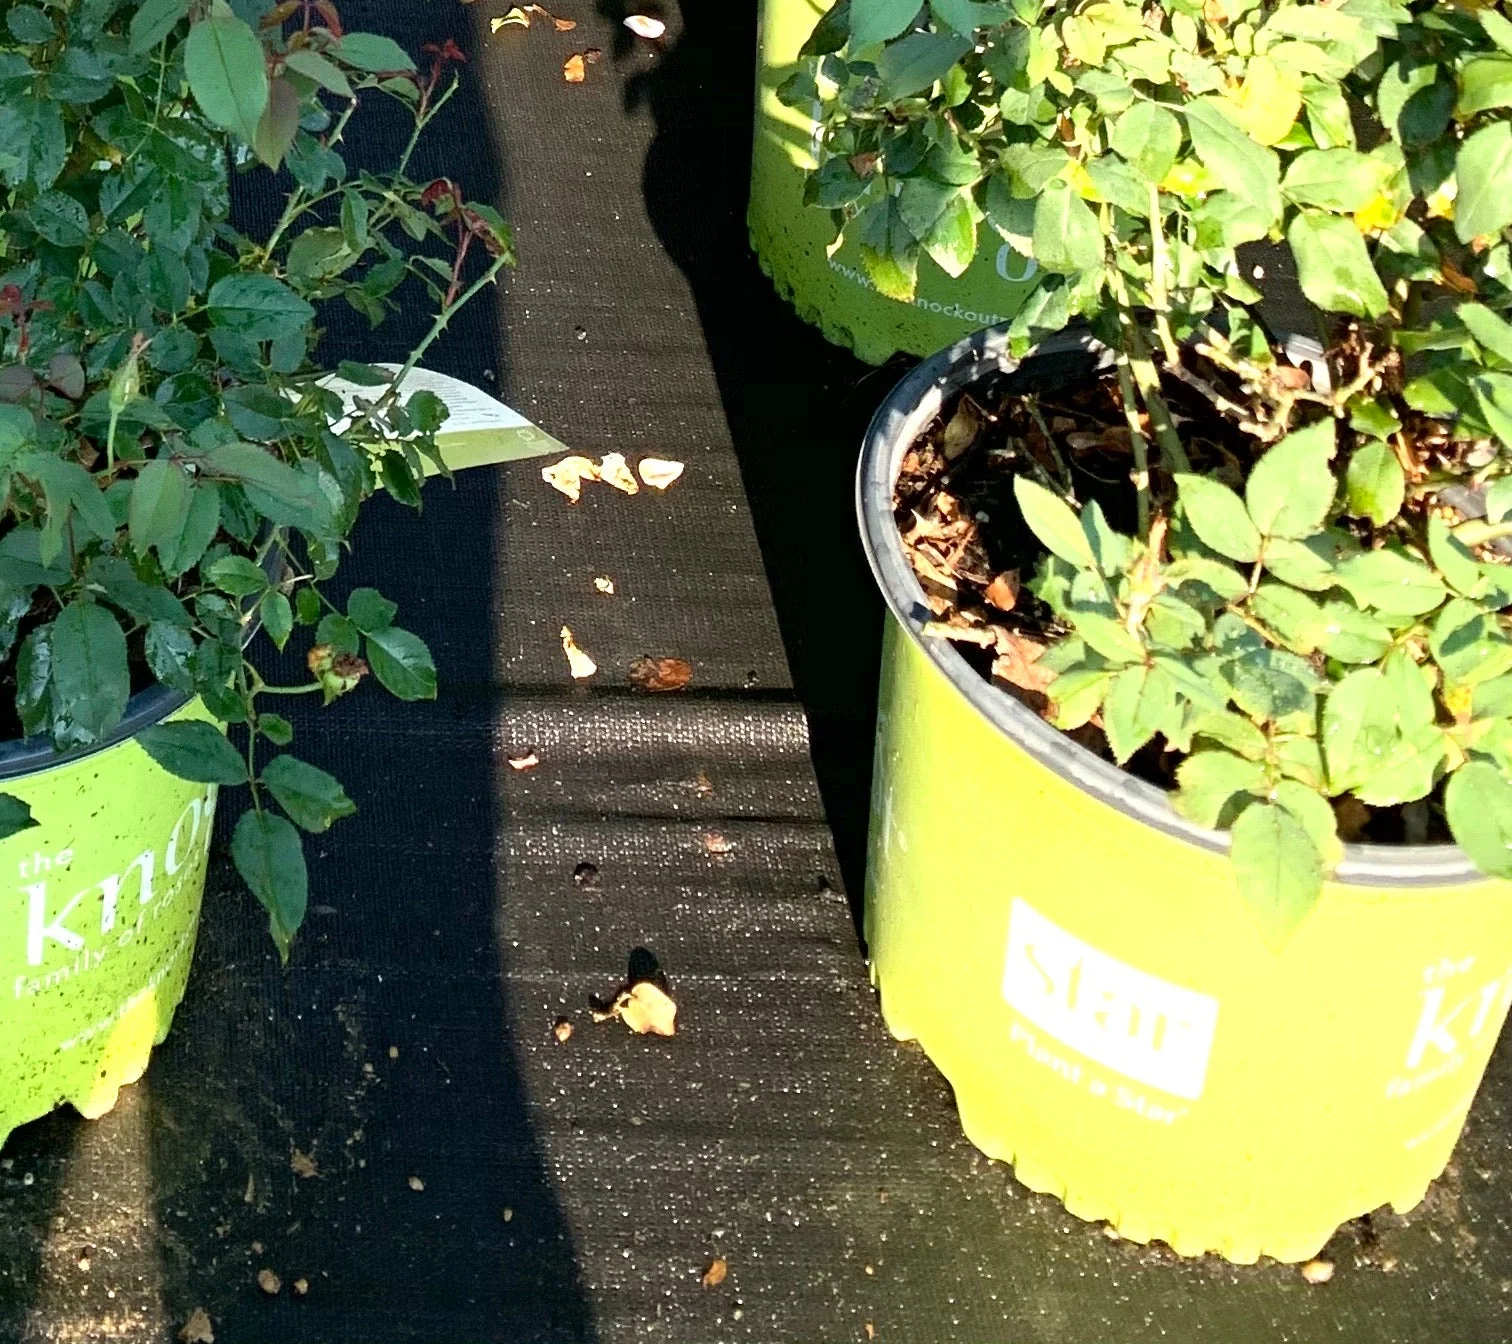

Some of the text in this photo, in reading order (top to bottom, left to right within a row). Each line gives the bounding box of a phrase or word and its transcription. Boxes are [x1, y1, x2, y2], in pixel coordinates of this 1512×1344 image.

[18, 849, 74, 879] the
[14, 945, 108, 1000] family
[1010, 1022, 1179, 1126] Plant a Star
